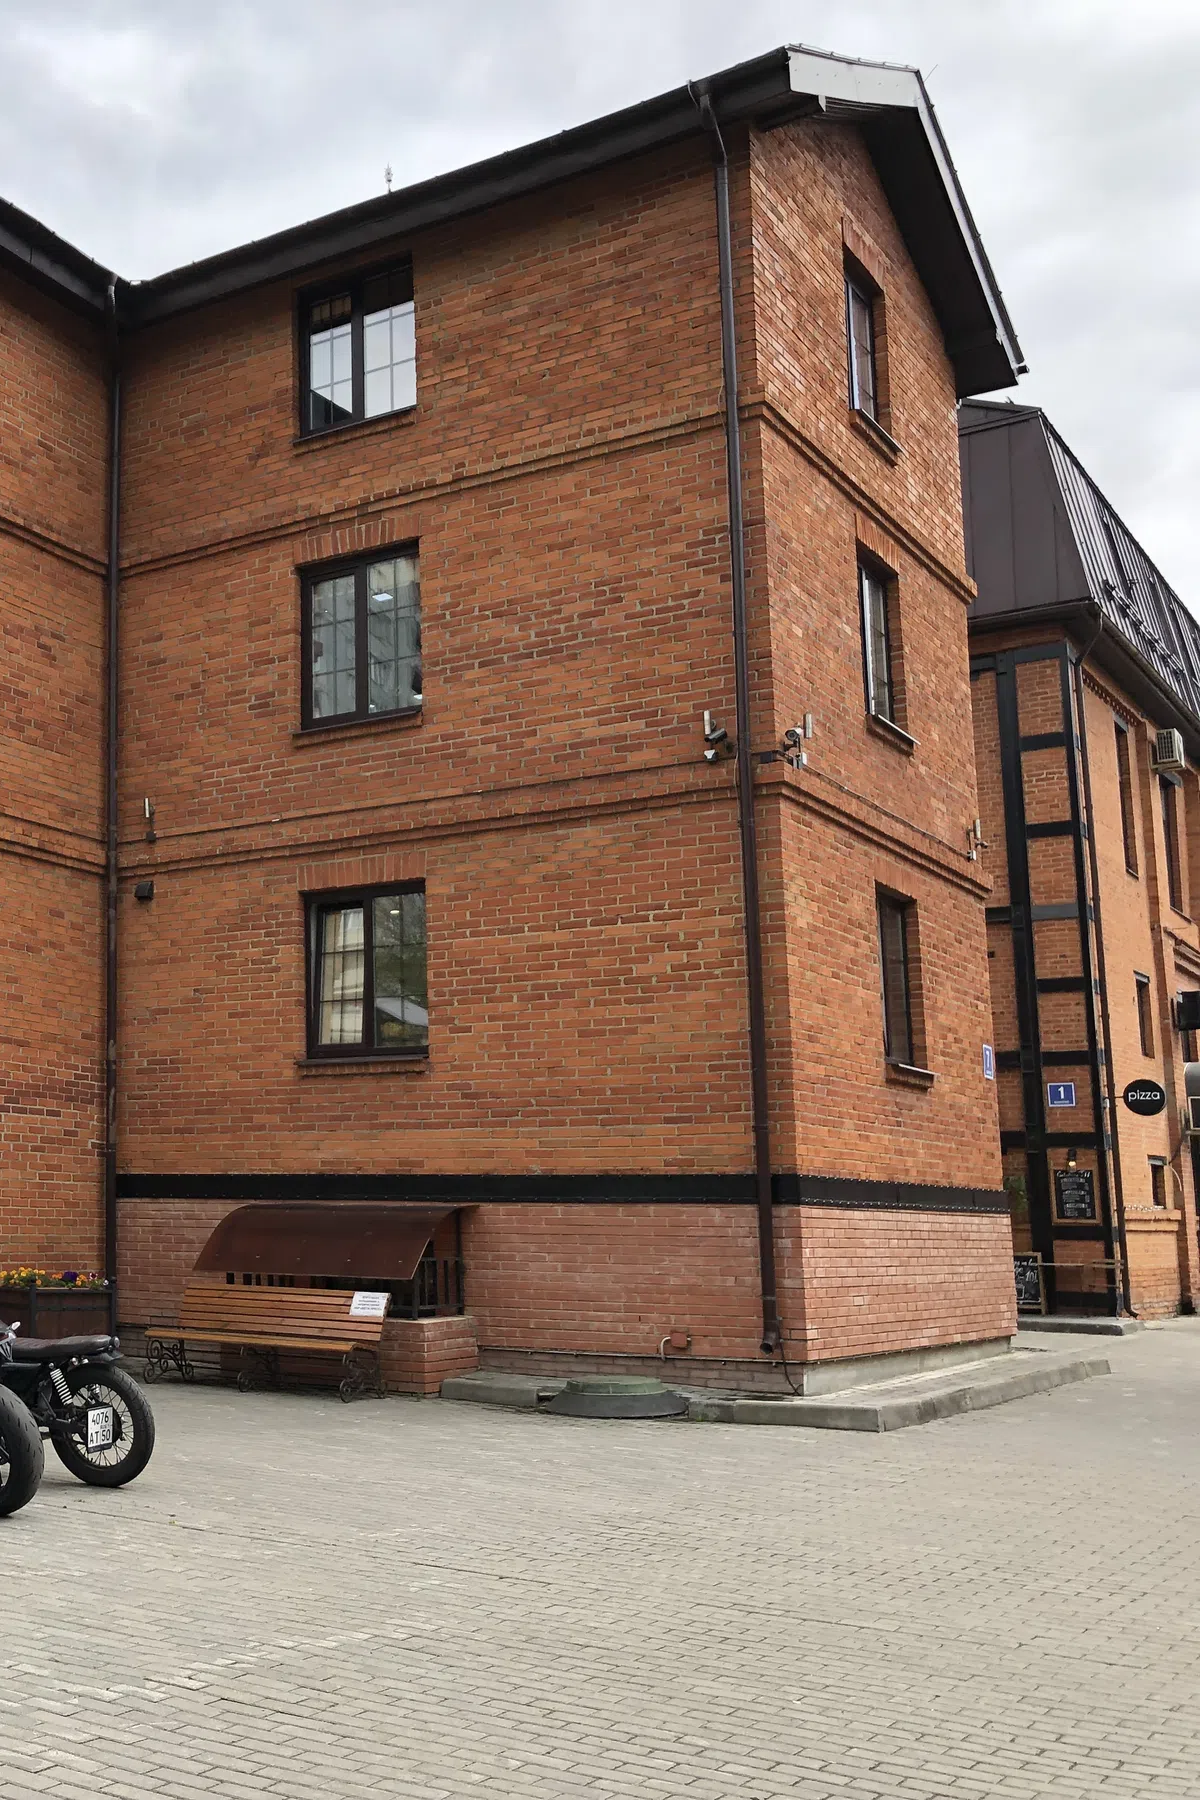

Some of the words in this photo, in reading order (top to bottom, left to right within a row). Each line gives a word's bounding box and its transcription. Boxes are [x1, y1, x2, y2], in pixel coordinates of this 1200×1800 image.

[1128, 1089, 1161, 1102] pizza
[91, 1411, 109, 1426] 4076
[101, 1429, 110, 1442] 50
